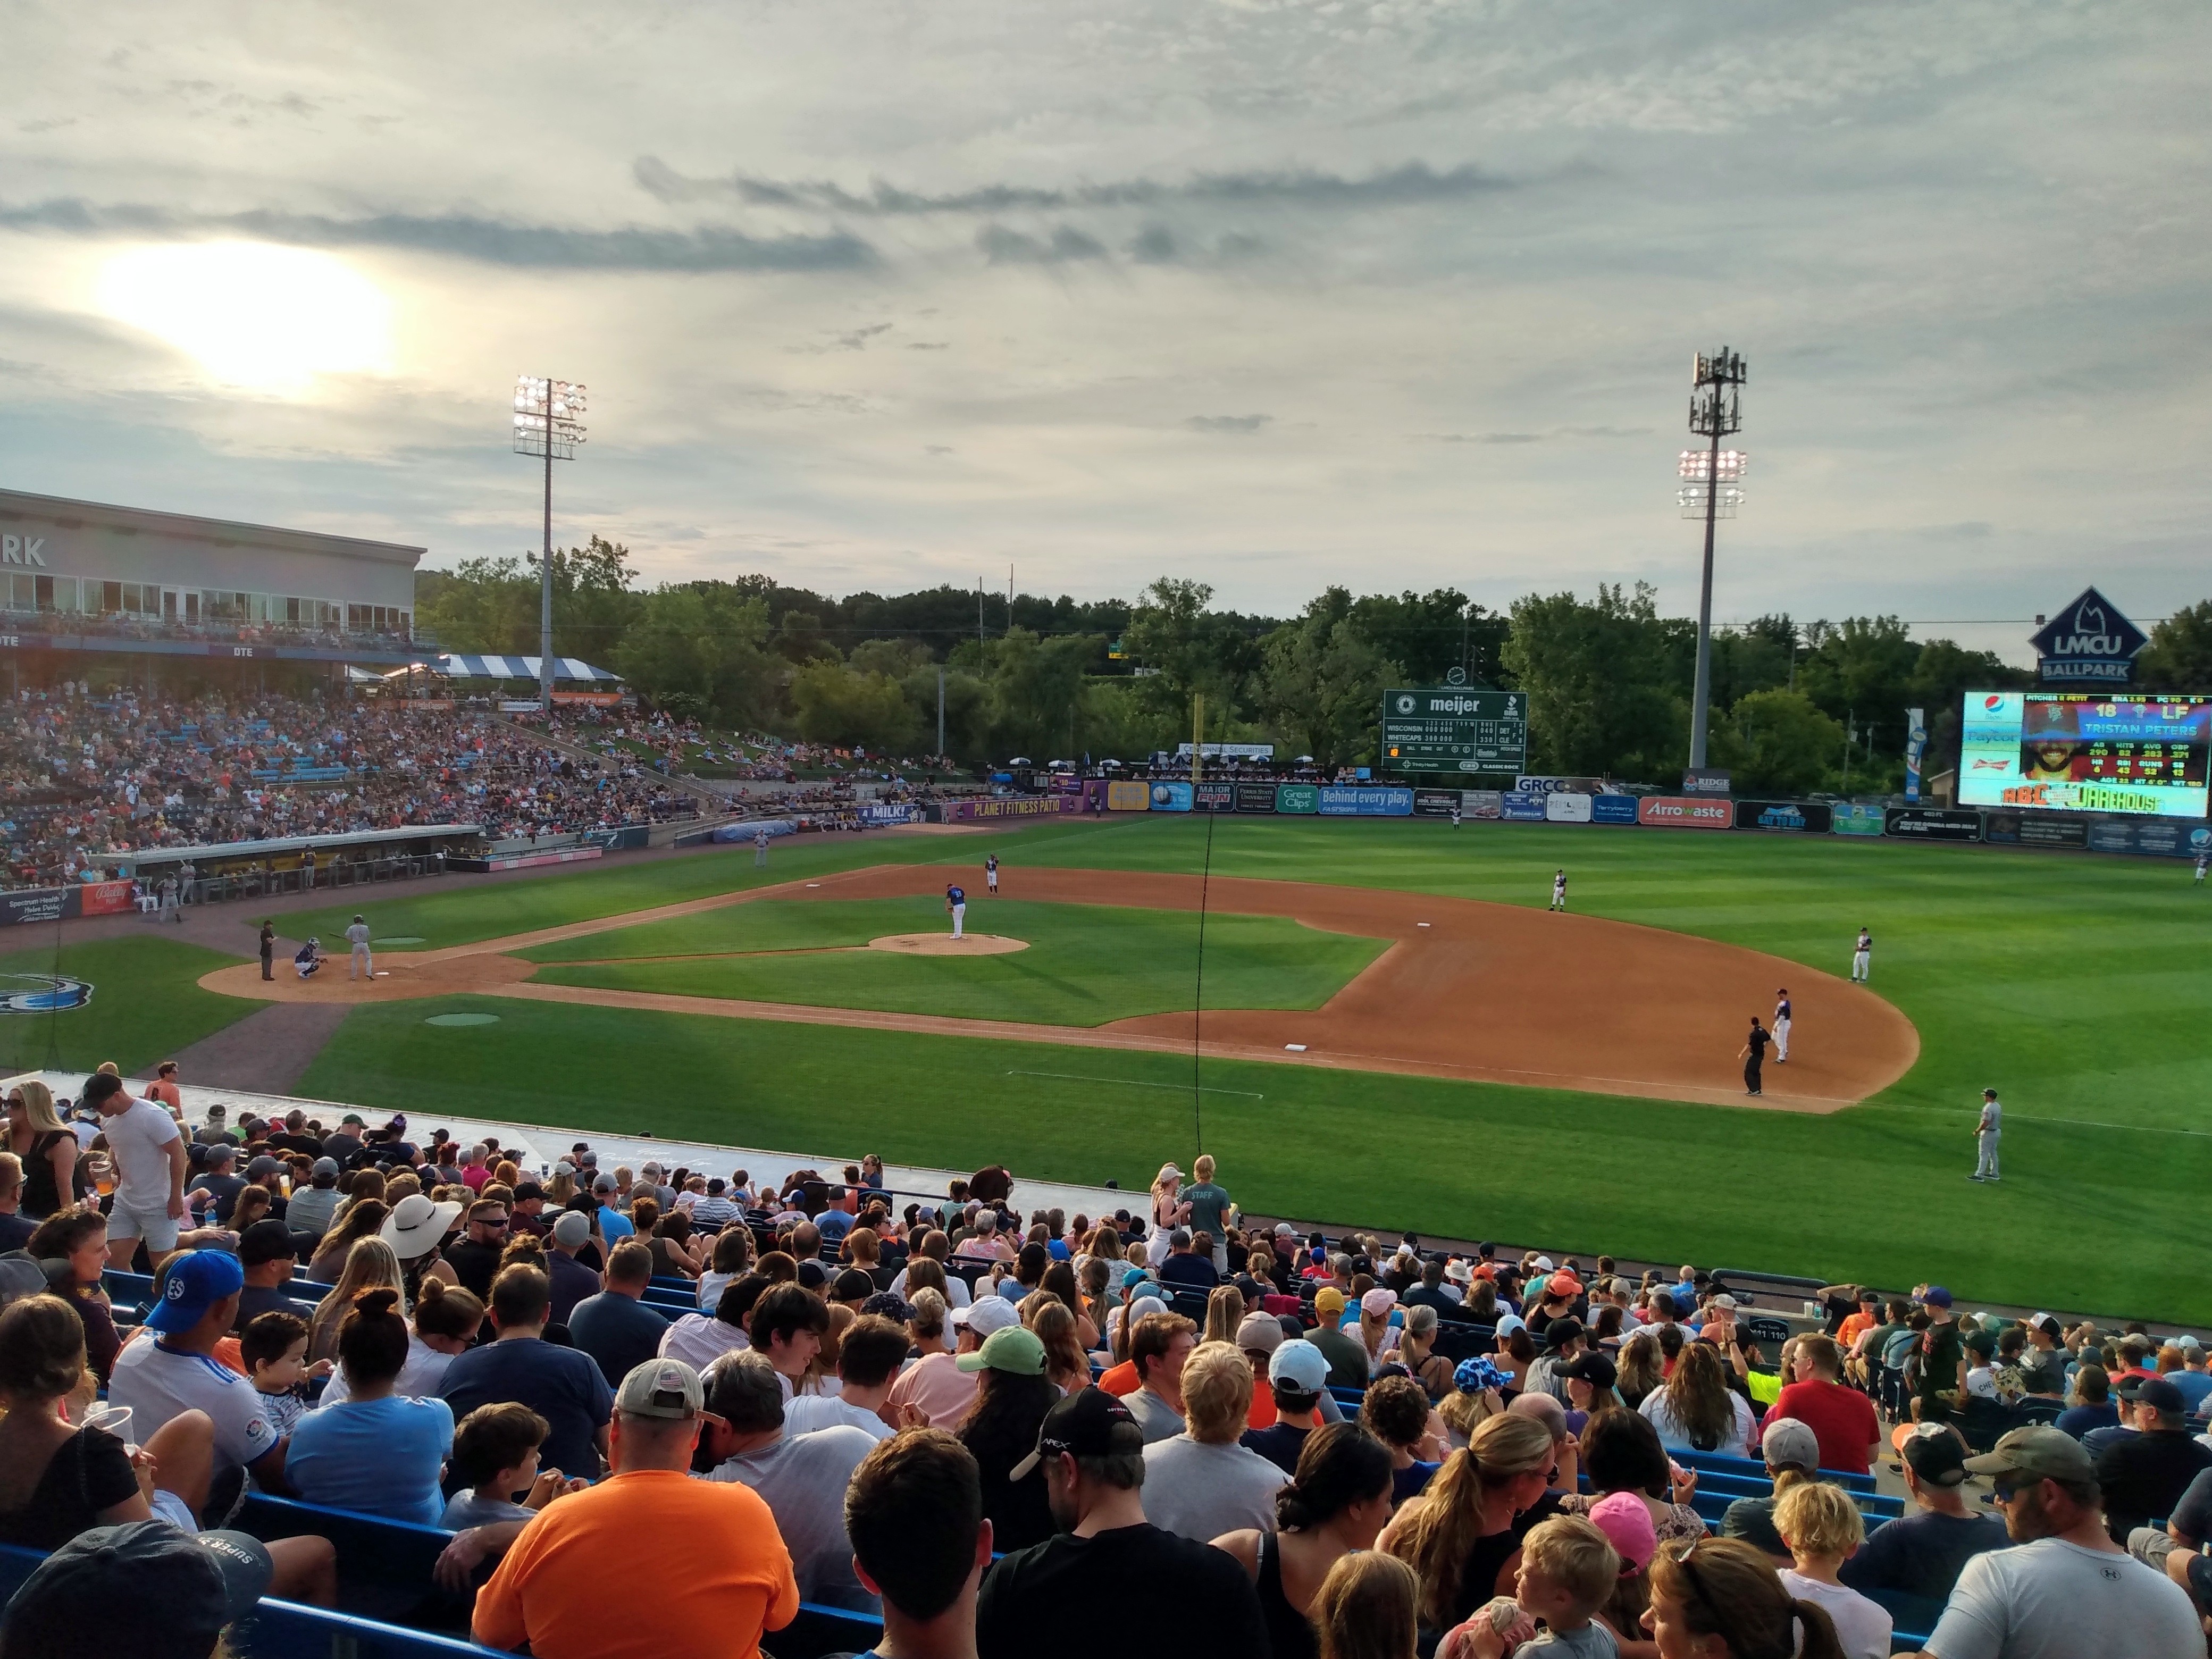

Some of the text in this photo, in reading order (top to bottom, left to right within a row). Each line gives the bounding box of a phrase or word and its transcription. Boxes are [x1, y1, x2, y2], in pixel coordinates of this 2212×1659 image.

[2054, 635, 2122, 655] LMCU
[234, 647, 253, 657] DTE
[2042, 665, 2130, 677] BALLPARK
[1430, 696, 1480, 716] meijer
[2096, 704, 2117, 718] 18
[2162, 705, 2189, 719] LF
[2085, 724, 2198, 736] TRISTAN PETERS
[1968, 731, 2017, 743] Paycor
[1390, 748, 1398, 757] 18
[1519, 778, 1565, 792] GRCC
[1284, 790, 1312, 799] Great
[1322, 790, 1409, 807] Behind every play.
[2003, 783, 2049, 805] ABC
[2064, 784, 2162, 810] WAREHOUSE
[974, 799, 1060, 817] PLANET FITNESS PATIO
[1285, 799, 1310, 809] Clips
[1646, 802, 1725, 818] Arrowaste
[872, 806, 906, 818] MILK!
[96, 885, 127, 900] Bally
[9, 899, 39, 908] Spectrum
[1191, 1191, 1213, 1200] STAFF
[167, 1279, 185, 1298] ES
[1771, 1331, 1786, 1340] 110
[1041, 1438, 1071, 1449] APEX
[210, 1541, 253, 1564] SUPER
